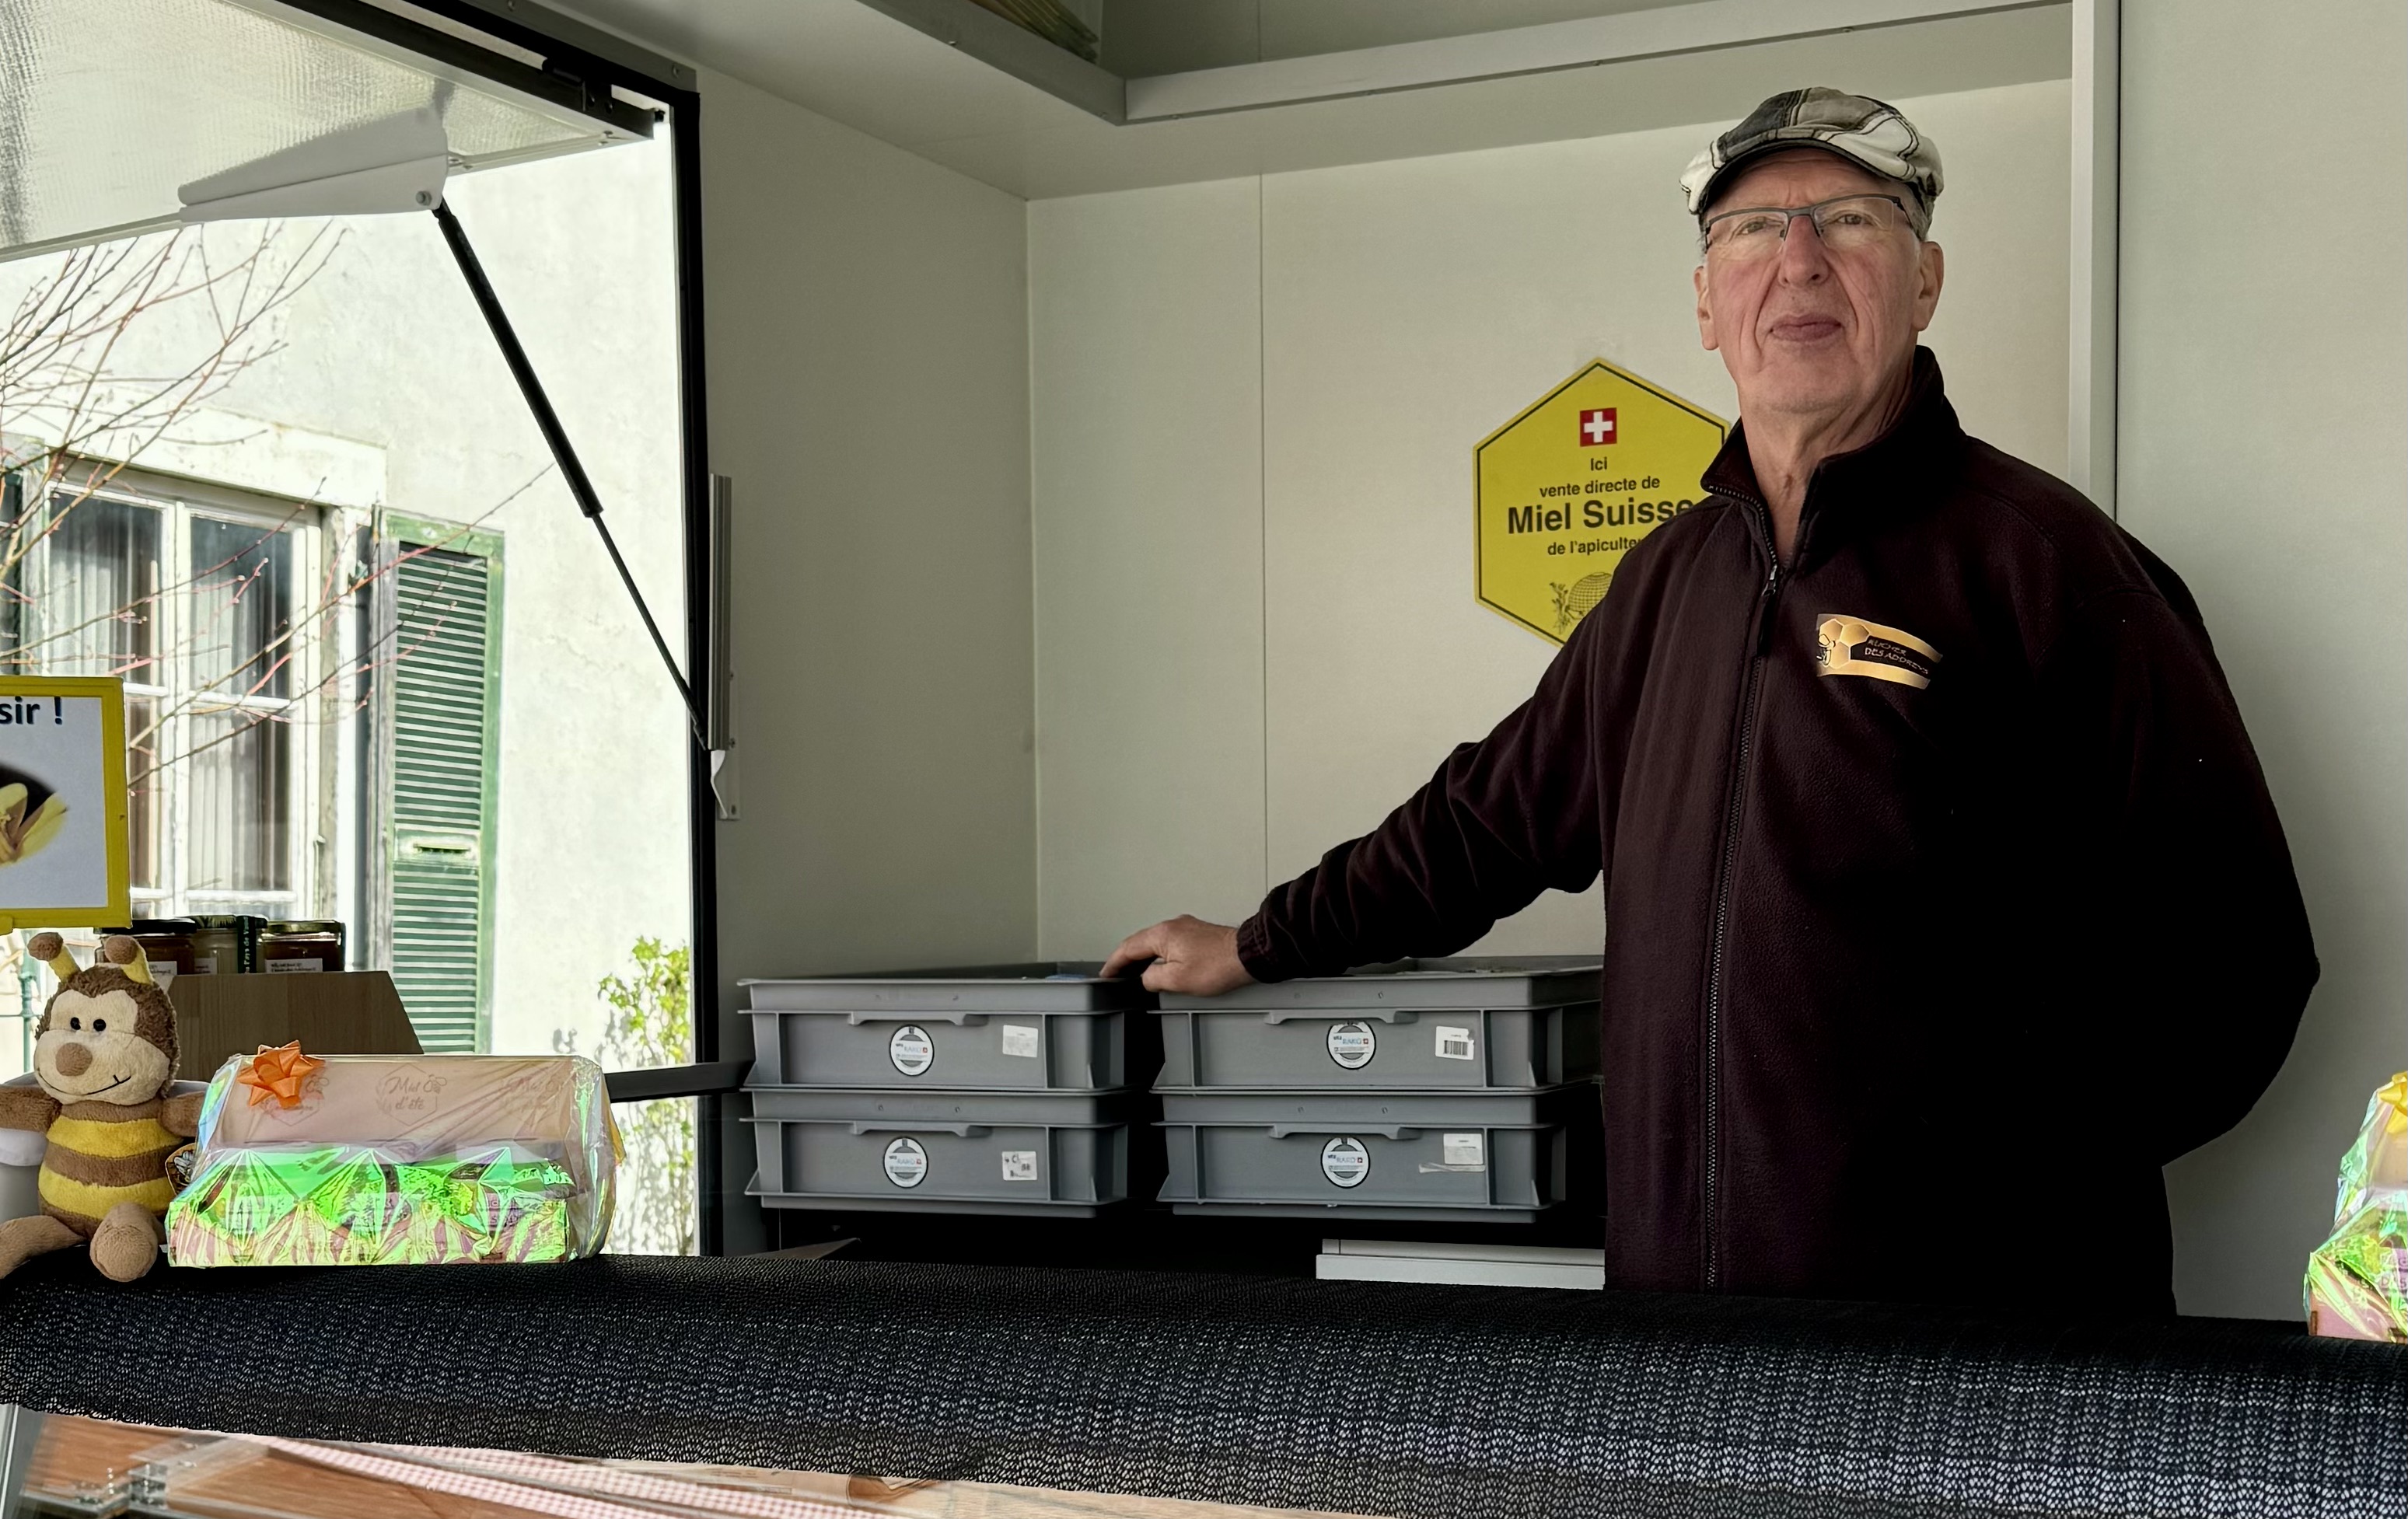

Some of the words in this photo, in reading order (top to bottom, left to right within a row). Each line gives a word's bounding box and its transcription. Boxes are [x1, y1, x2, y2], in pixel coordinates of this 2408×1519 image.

[1590, 457, 1608, 471] Ici
[1540, 482, 1581, 498] vente
[1585, 478, 1637, 494] directe
[1641, 476, 1660, 490] de
[1508, 502, 1571, 534] Miel
[1547, 542, 1566, 555] de
[1570, 536, 1641, 555] l'apiculte
